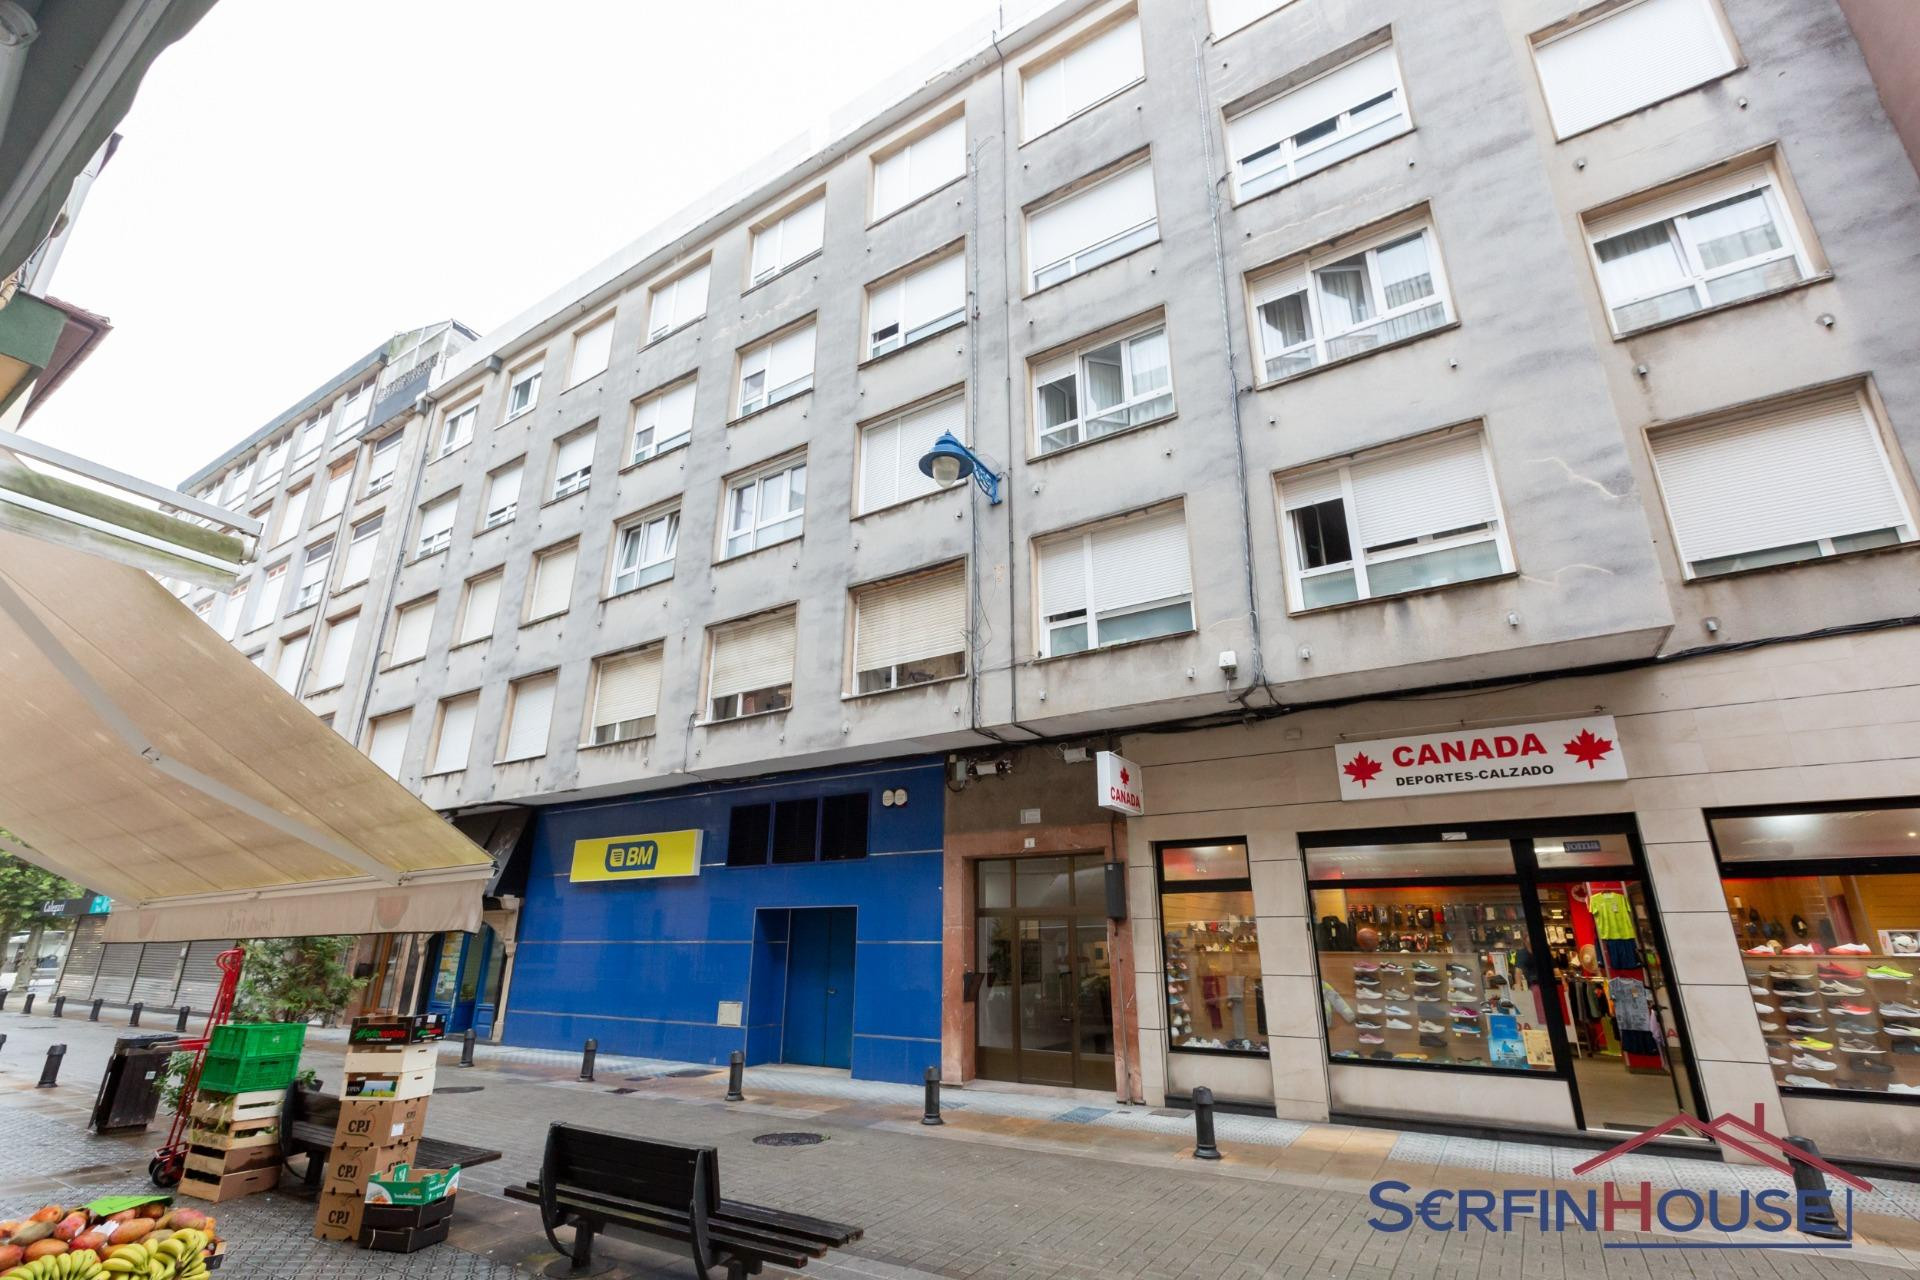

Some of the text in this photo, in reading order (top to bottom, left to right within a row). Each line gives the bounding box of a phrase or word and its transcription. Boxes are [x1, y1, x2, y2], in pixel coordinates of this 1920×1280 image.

[1392, 733, 1547, 767] CANADA
[1396, 765, 1554, 786] DEPORTES-CALZADO
[1110, 786, 1141, 808] CANADA
[625, 845, 654, 866] BM
[348, 1119, 371, 1133] CPJ
[337, 1164, 359, 1178] CPJ
[328, 1210, 350, 1224] CPJ
